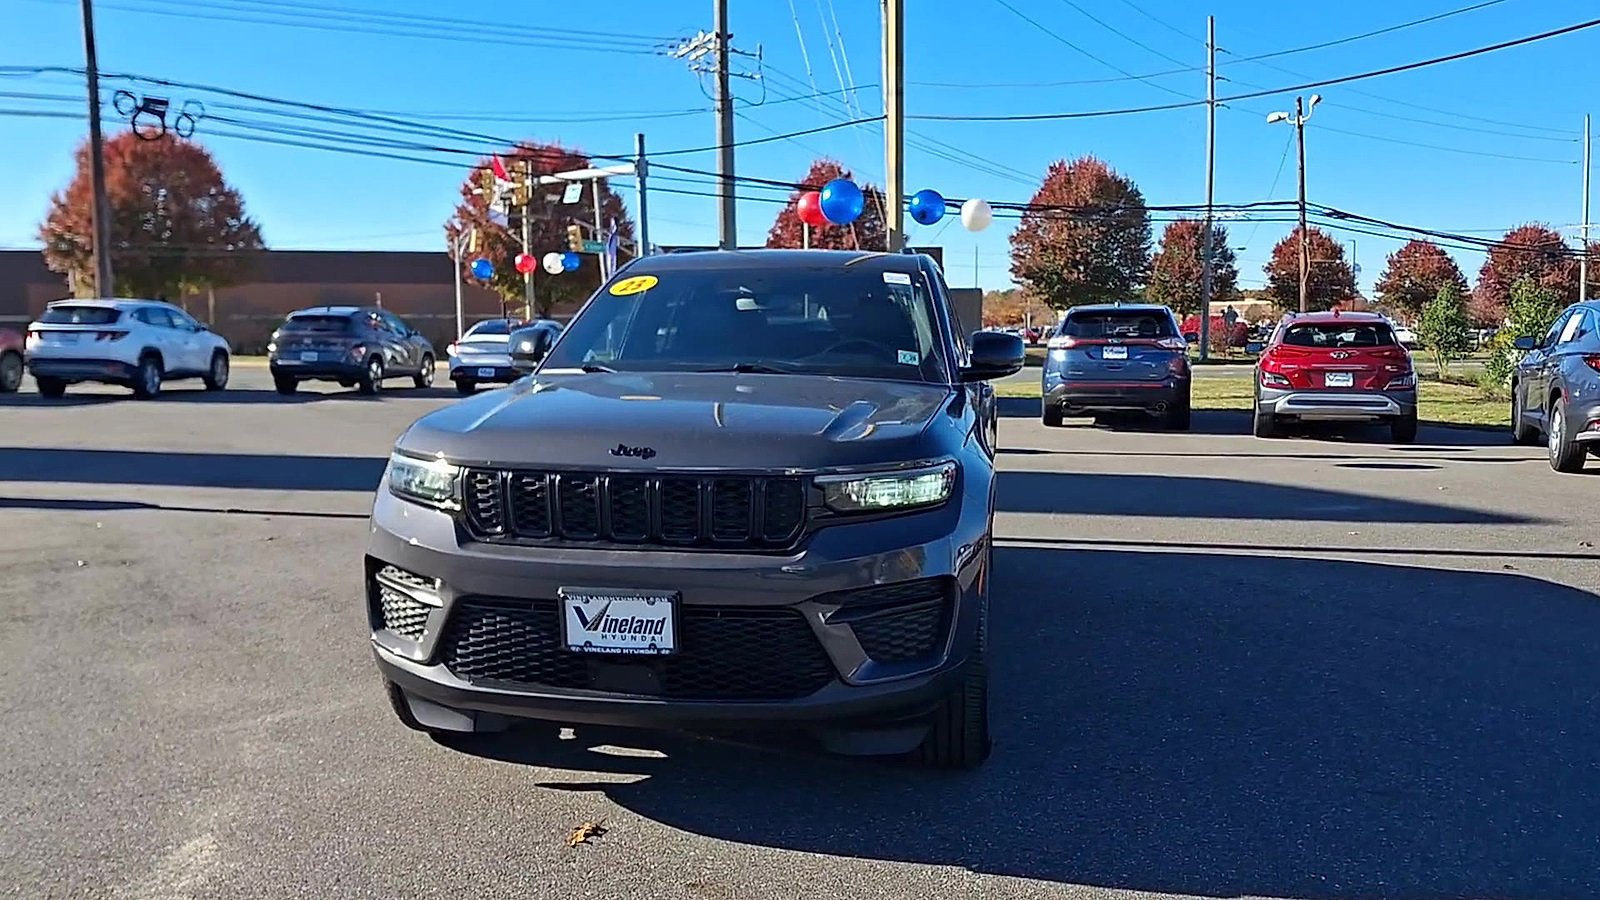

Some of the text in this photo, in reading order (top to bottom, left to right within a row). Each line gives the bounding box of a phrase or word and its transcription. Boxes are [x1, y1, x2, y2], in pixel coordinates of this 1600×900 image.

[607, 443, 657, 460] Jeep
[572, 600, 667, 635] Vineland
[601, 634, 663, 642] HYUNDAI
